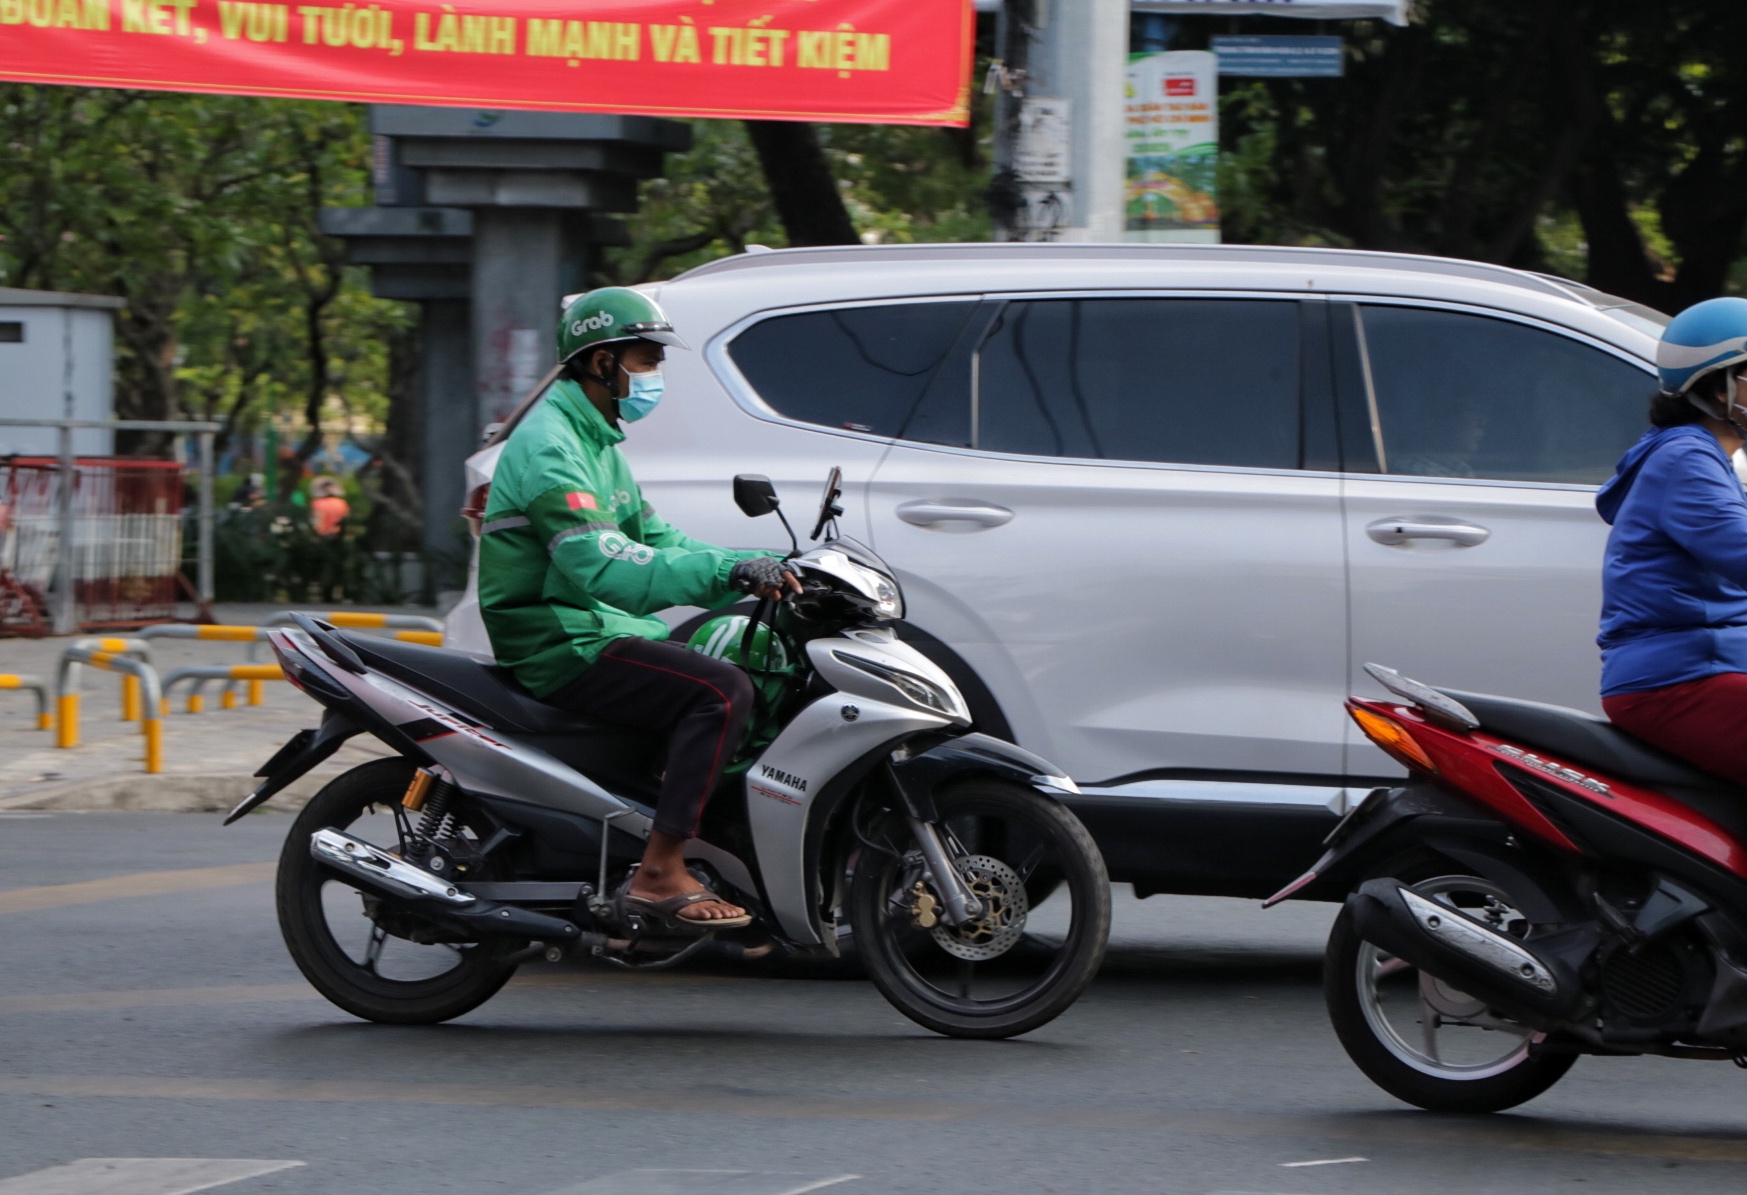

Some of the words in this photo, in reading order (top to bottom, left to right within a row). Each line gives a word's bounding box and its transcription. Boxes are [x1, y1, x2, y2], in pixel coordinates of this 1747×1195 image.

[218, 1, 288, 42] VUI
[298, 3, 404, 56] TƯƠI,
[414, 4, 516, 55] LÀNH
[526, 18, 641, 67] MẠNH
[649, 15, 701, 63] VÀ
[708, 14, 790, 67] TIẾT
[797, 22, 890, 79] KIỆM
[571, 310, 614, 336] Grab
[761, 764, 807, 792] YAMAHA
